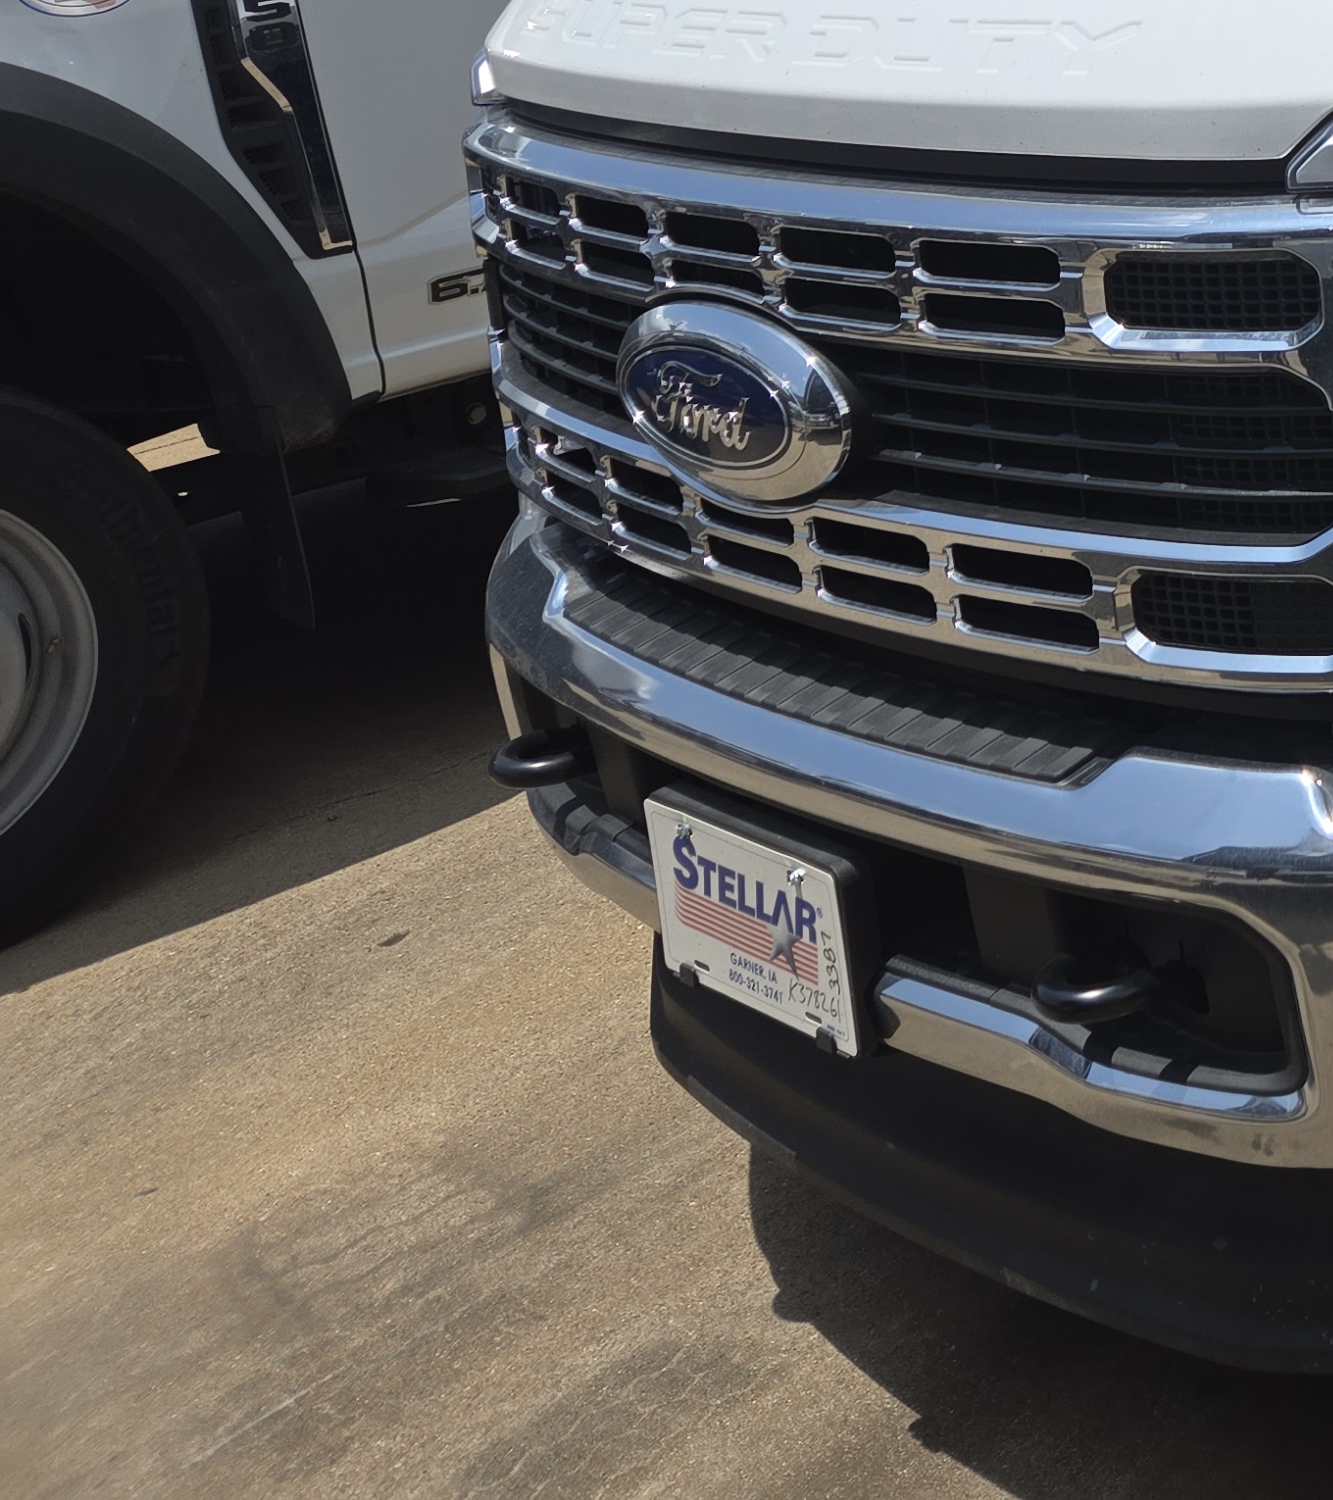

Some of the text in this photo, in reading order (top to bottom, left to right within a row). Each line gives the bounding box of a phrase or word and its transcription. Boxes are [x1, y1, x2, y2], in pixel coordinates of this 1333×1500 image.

[793, 13, 1143, 76] DUTY
[651, 361, 750, 450] Ford
[673, 836, 817, 945] STELLAR
[730, 953, 778, 984] GARNER, IA
